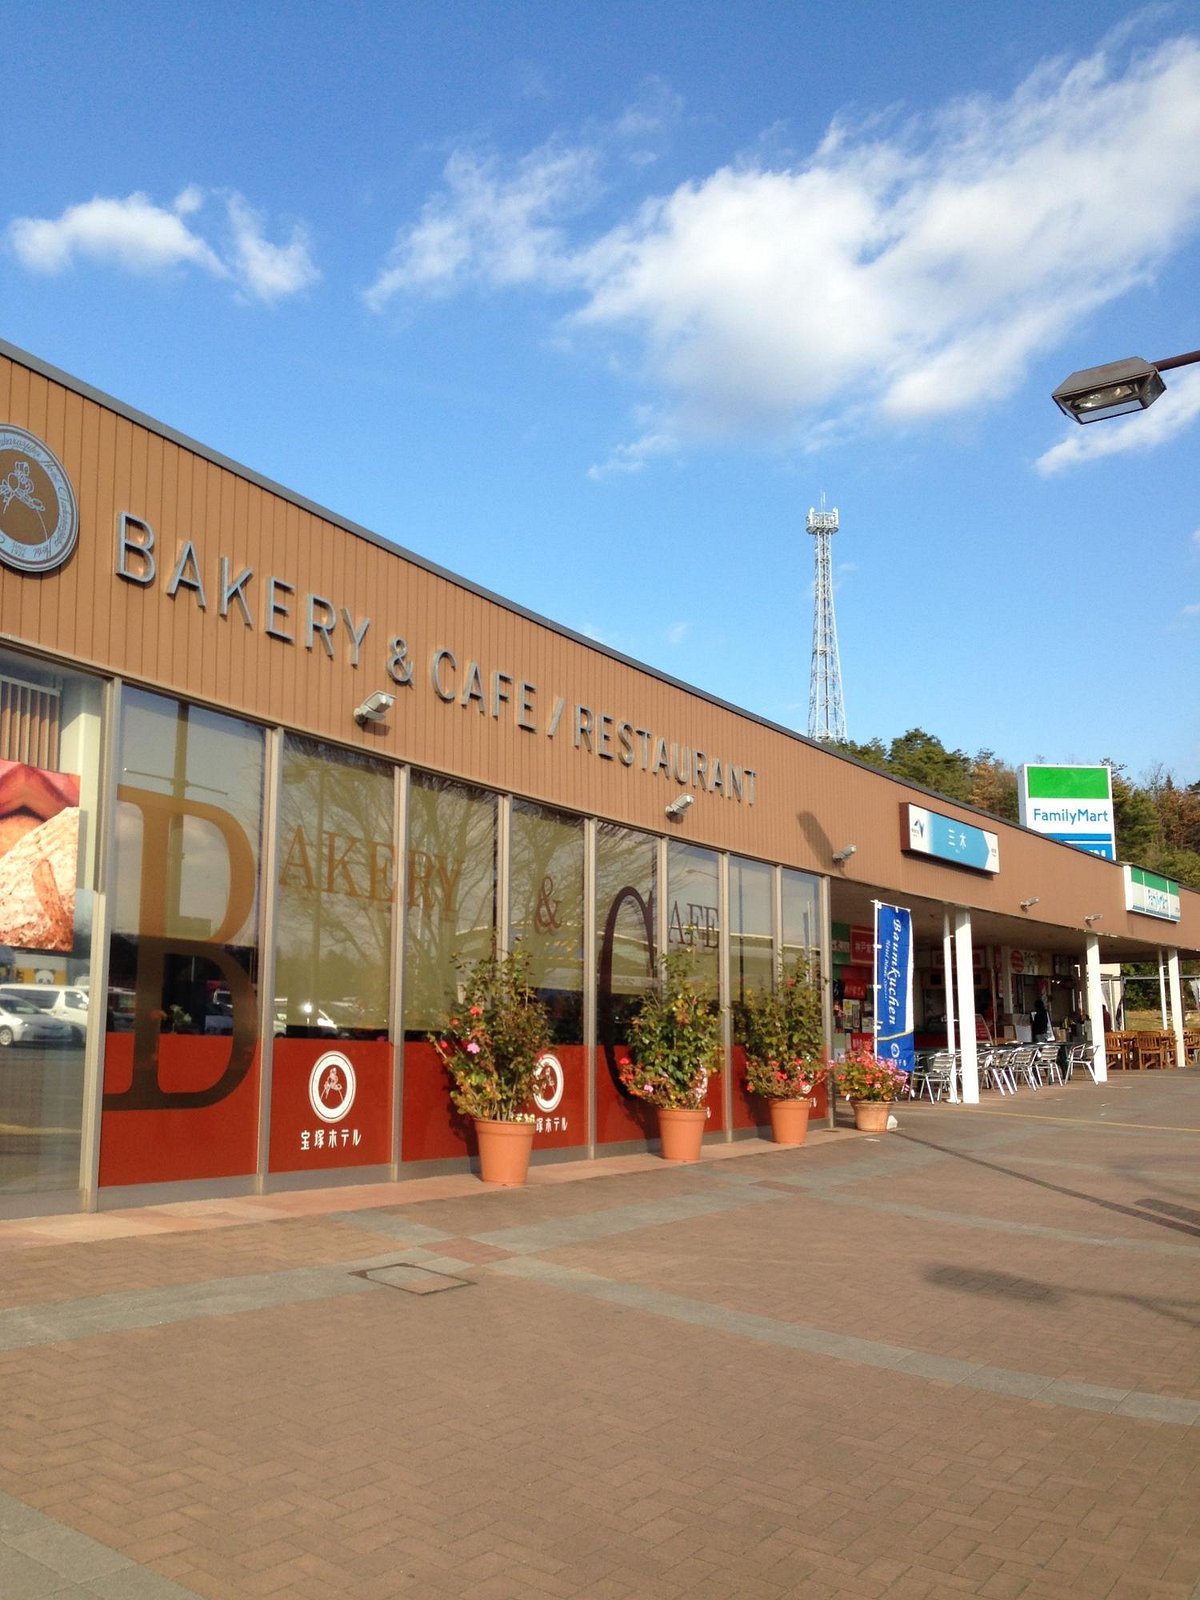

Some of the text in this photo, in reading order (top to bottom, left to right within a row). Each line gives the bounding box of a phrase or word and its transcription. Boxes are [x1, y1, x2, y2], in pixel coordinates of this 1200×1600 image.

[115, 511, 370, 668] BAKERY
[387, 636, 413, 686] &
[432, 648, 538, 732] CAFE
[574, 704, 757, 806] RESTAURANT
[1033, 808, 1108, 825] FamilyMart
[947, 828, 967, 850] 三木
[887, 918, 902, 1026] Baumkuchen
[535, 1116, 569, 1133] 塚ホテル
[300, 1128, 362, 1151] 宝塚ホテル
